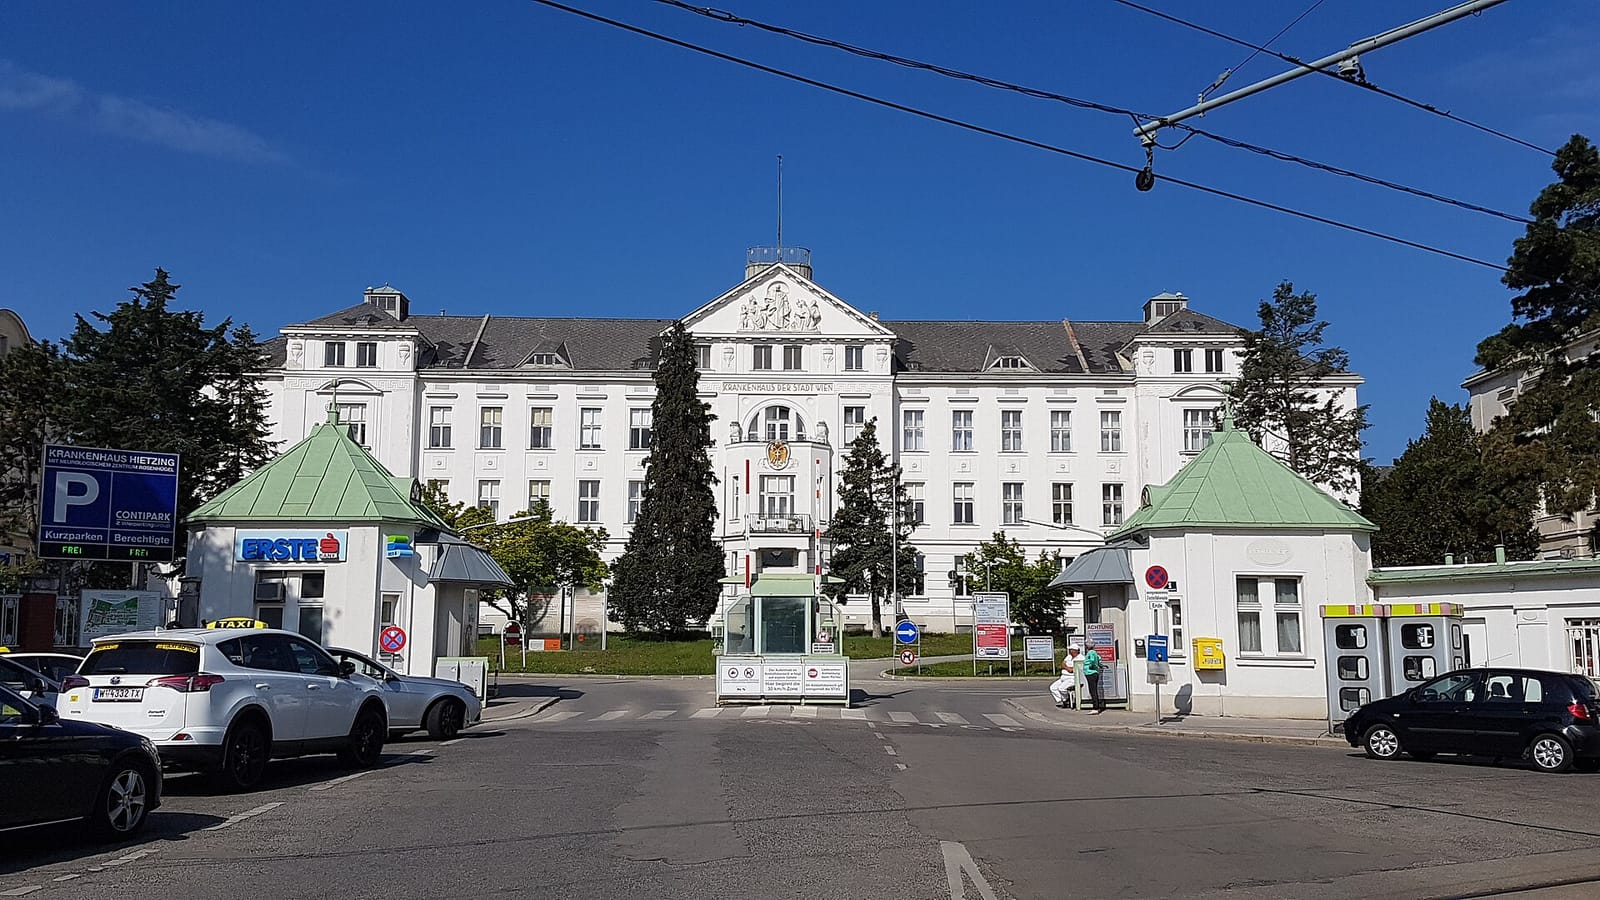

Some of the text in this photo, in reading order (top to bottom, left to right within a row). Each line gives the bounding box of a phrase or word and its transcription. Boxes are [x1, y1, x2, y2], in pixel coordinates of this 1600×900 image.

[722, 383, 833, 392] KRANKENHAUS DER STADT WIEN
[49, 449, 175, 467] KRANKENHAUS HIETZING
[53, 471, 100, 523] P
[115, 510, 171, 521] CONTIPARK
[45, 530, 103, 541] Kurzparken
[114, 533, 170, 545] Berechtigte
[62, 546, 82, 555] FREI
[129, 548, 149, 557] FREI
[242, 538, 318, 560] ERSTE
[219, 620, 251, 628] TAXI
[99, 689, 141, 698] W 4332 TX
